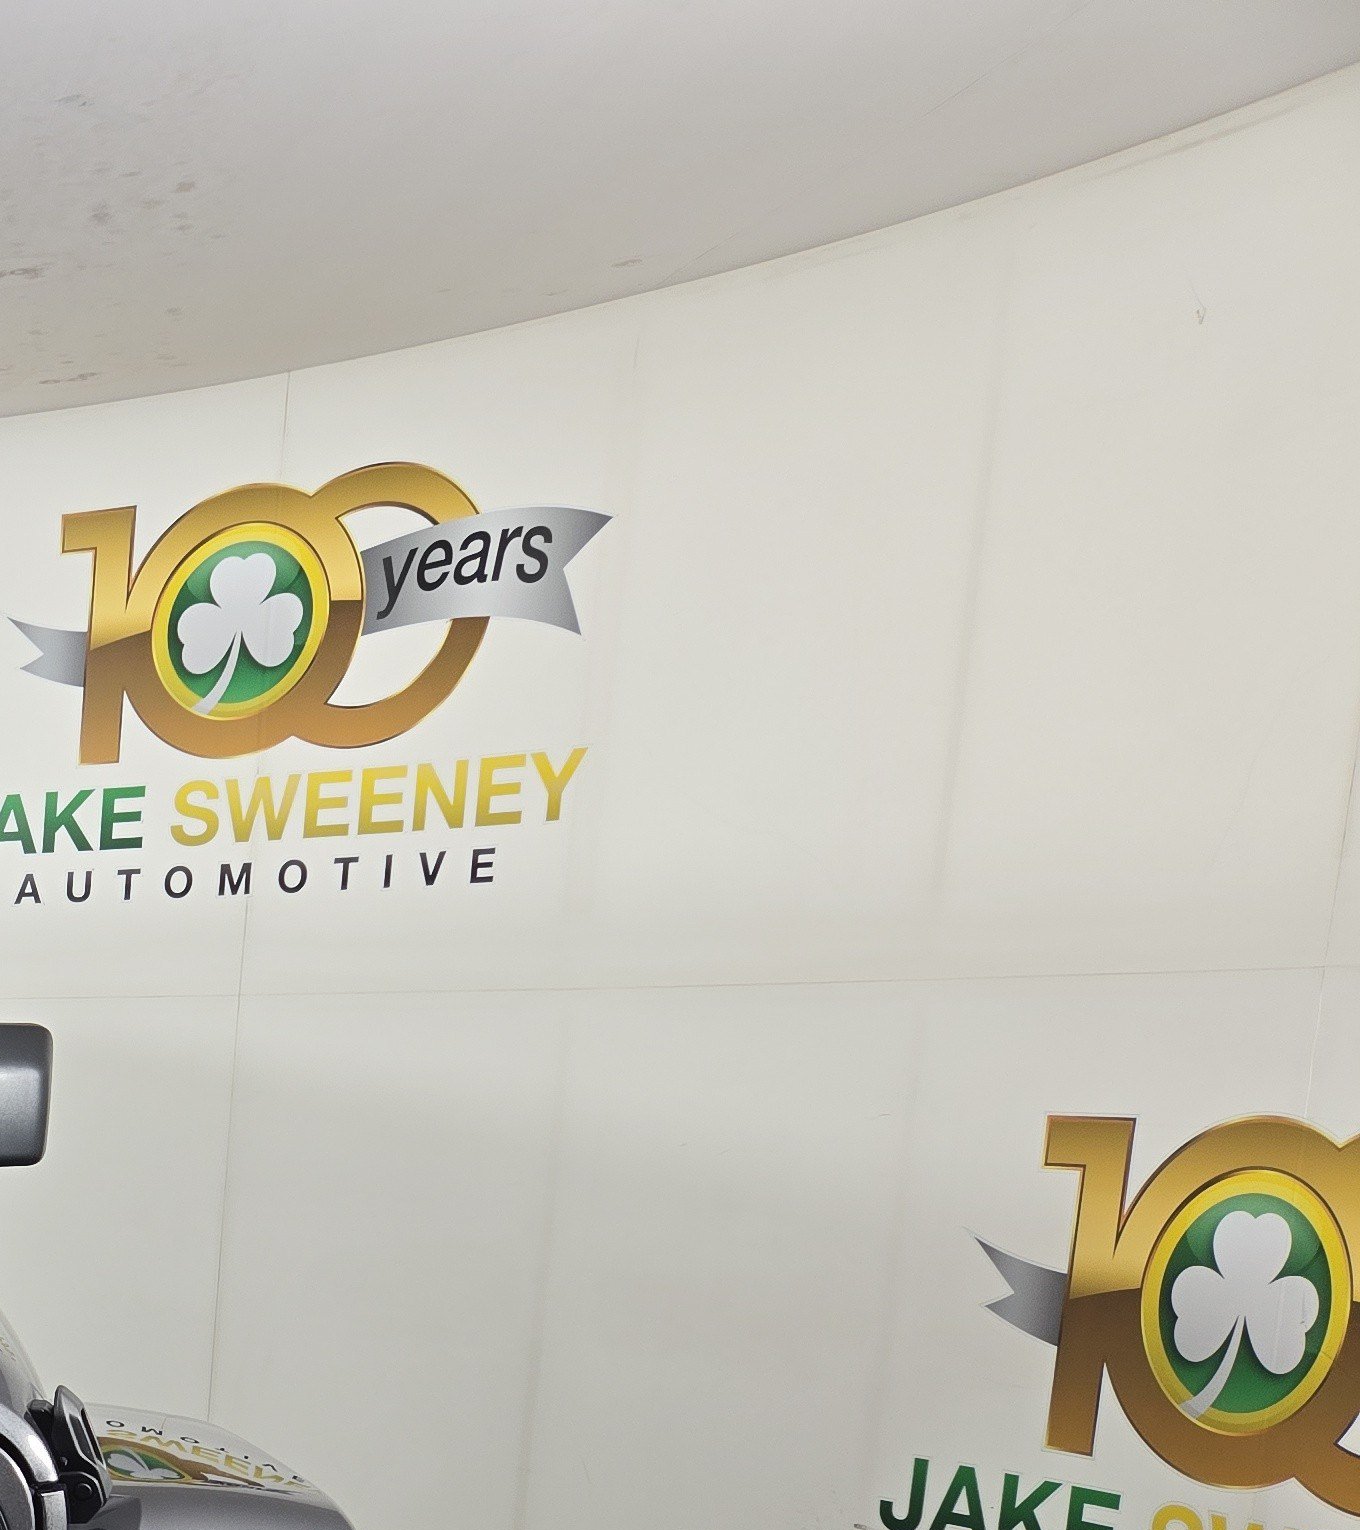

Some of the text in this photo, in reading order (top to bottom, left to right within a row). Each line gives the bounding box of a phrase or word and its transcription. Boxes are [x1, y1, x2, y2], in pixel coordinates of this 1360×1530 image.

[376, 525, 553, 620] years
[170, 747, 589, 848] SWEENEY
[14, 847, 497, 905] AUTOMOTIVE
